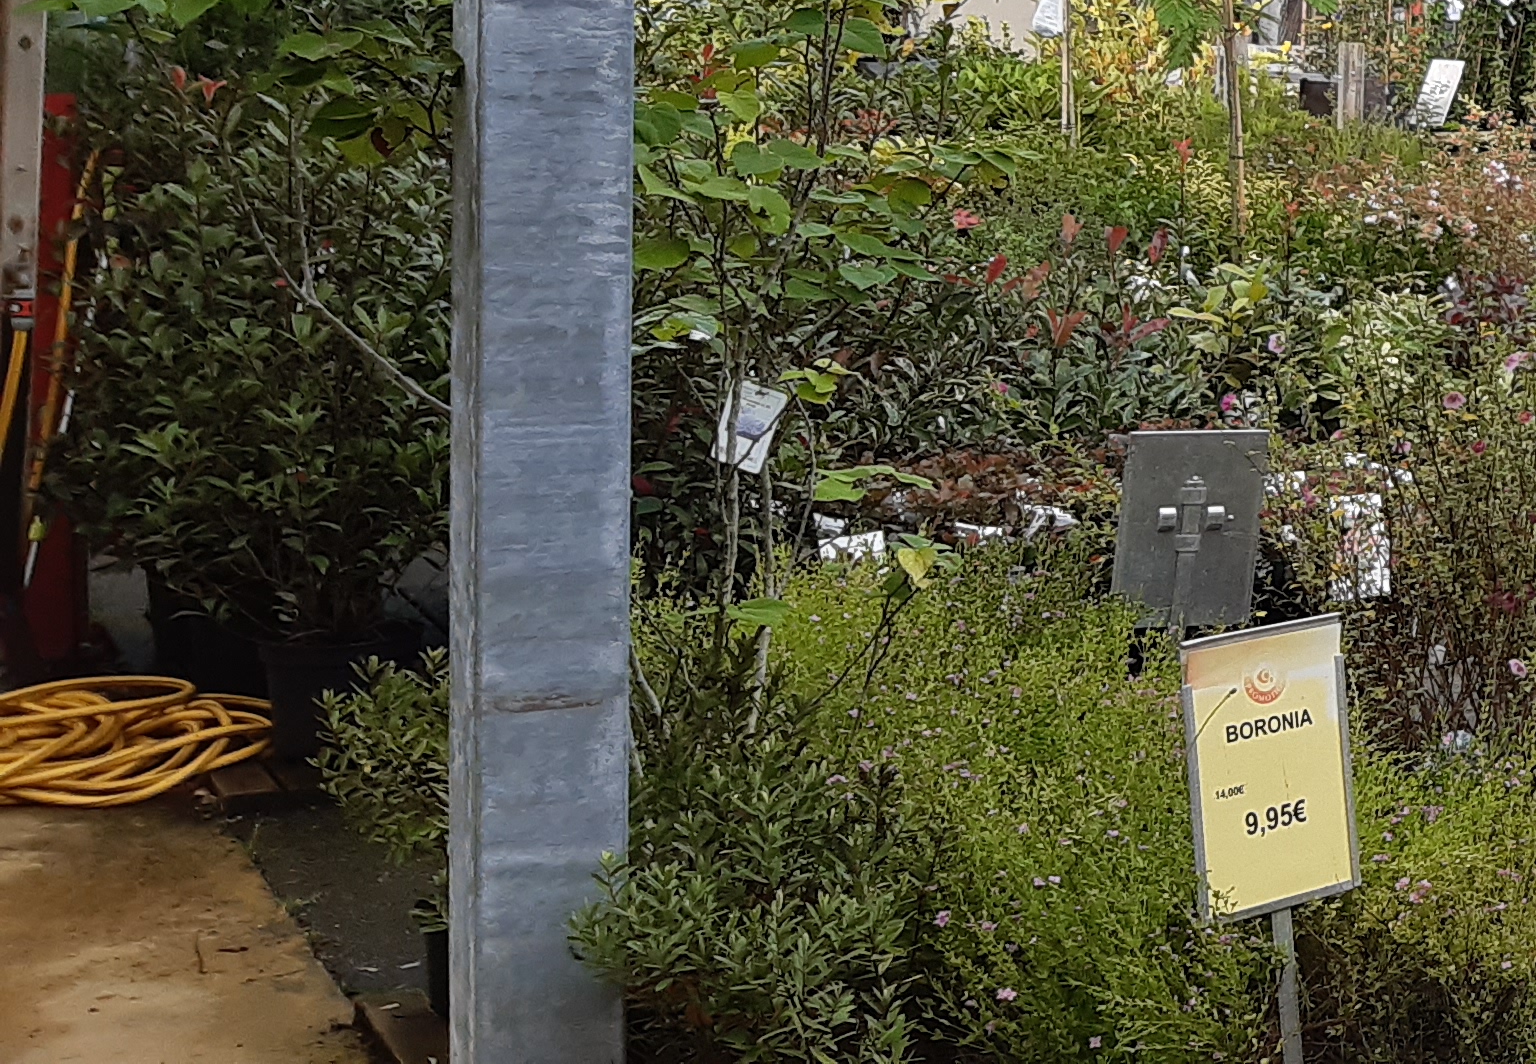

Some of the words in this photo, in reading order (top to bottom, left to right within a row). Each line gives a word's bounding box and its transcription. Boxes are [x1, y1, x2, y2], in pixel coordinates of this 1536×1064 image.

[1225, 708, 1313, 744] BORONIA
[1214, 784, 1245, 800] 14,00€
[1245, 799, 1307, 837] 9,95€
